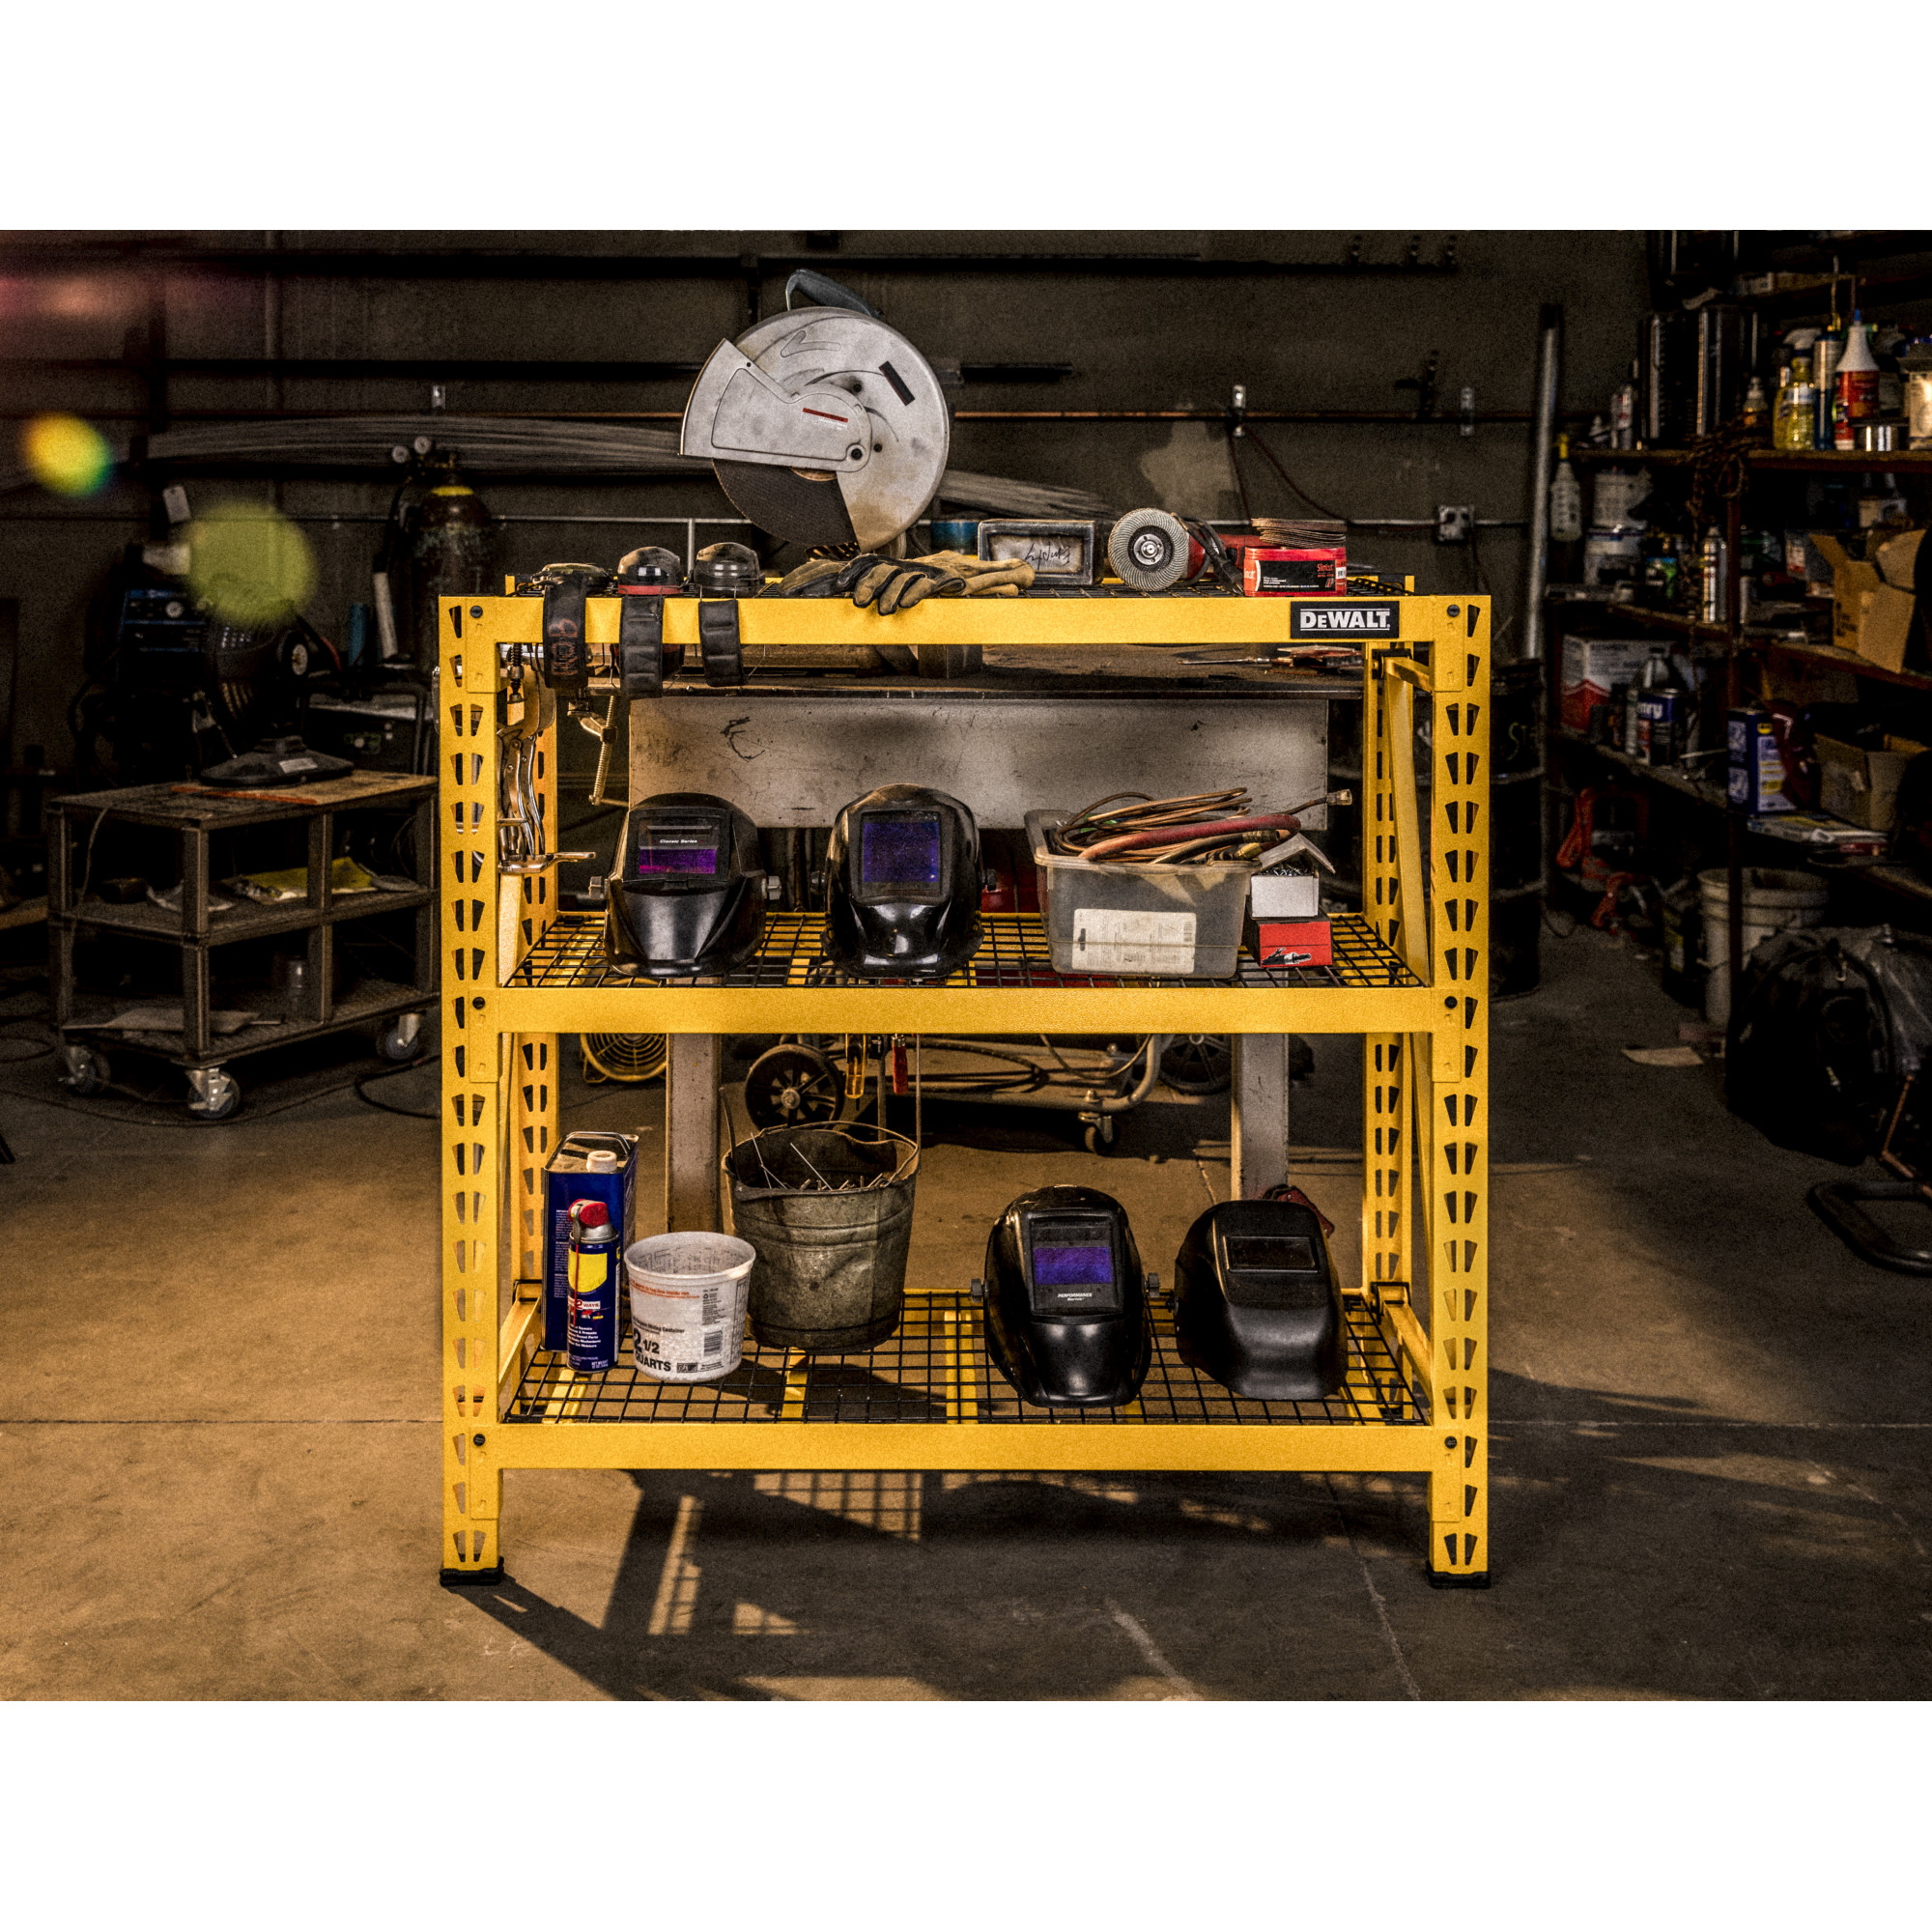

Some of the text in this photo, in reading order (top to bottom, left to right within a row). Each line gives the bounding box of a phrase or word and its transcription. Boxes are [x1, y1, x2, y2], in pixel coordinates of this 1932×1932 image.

[633, 1327, 660, 1354] 2 1/2
[635, 1350, 671, 1372] QUARTS
